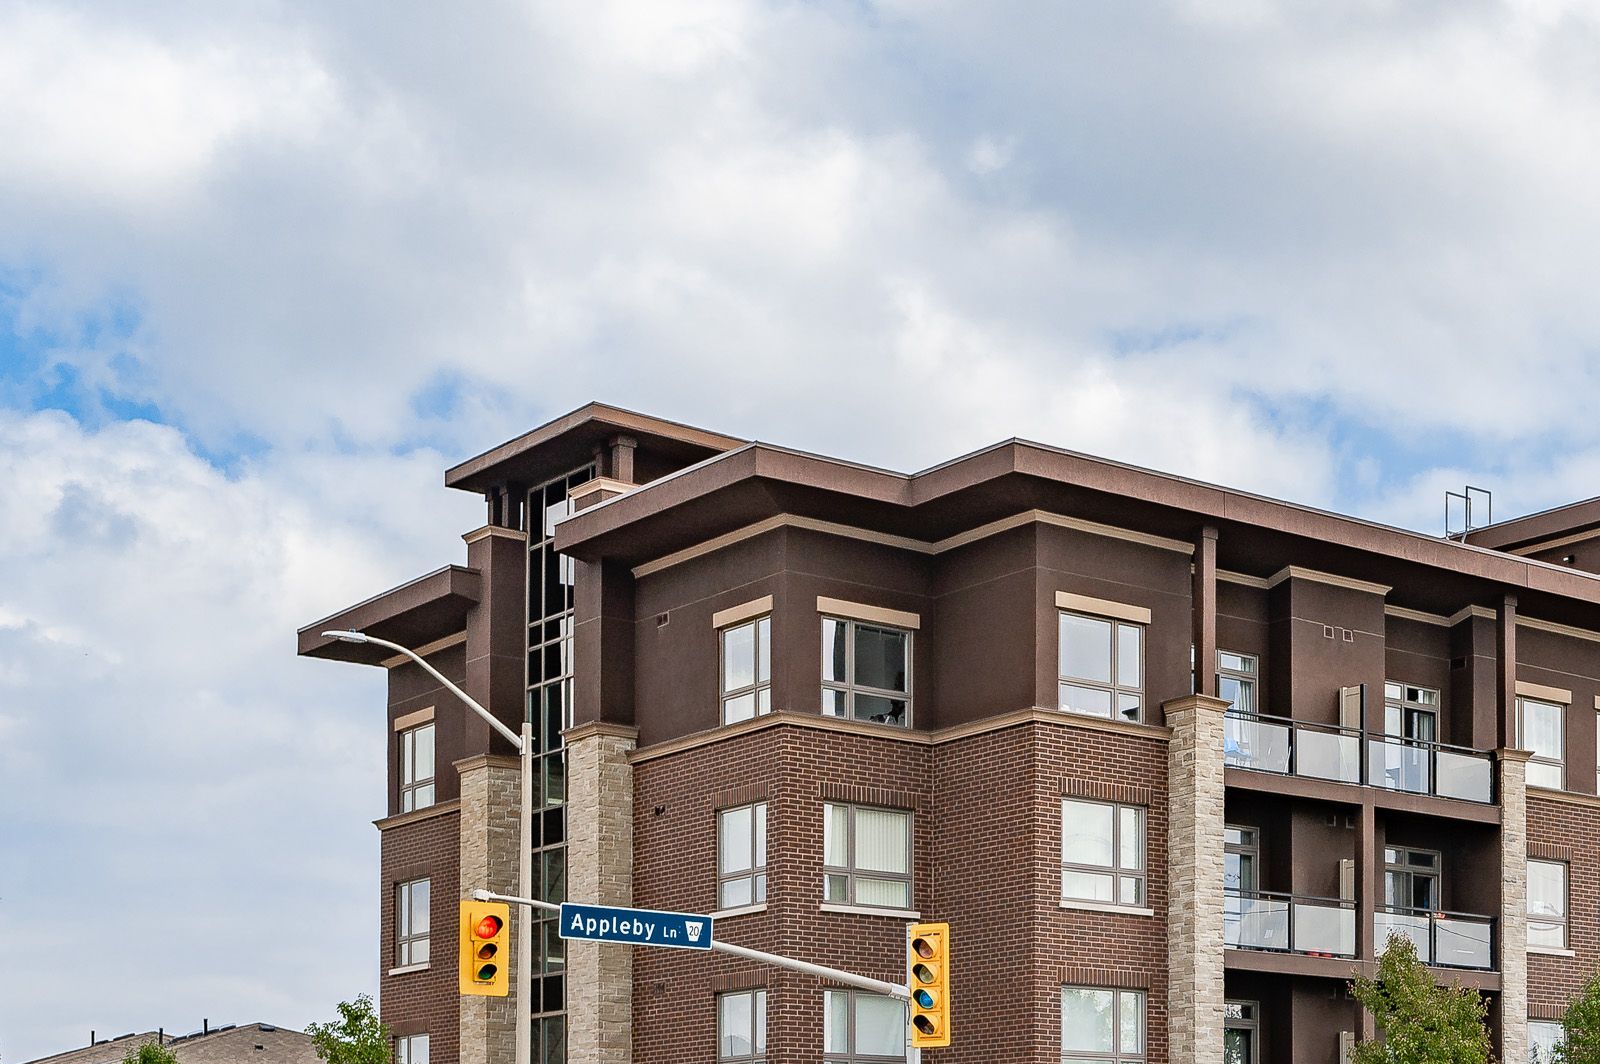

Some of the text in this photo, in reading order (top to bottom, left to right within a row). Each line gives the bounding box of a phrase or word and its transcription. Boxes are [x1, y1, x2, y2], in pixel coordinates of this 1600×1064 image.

[571, 913, 677, 940] Appleby Ln
[688, 925, 700, 936] 20
